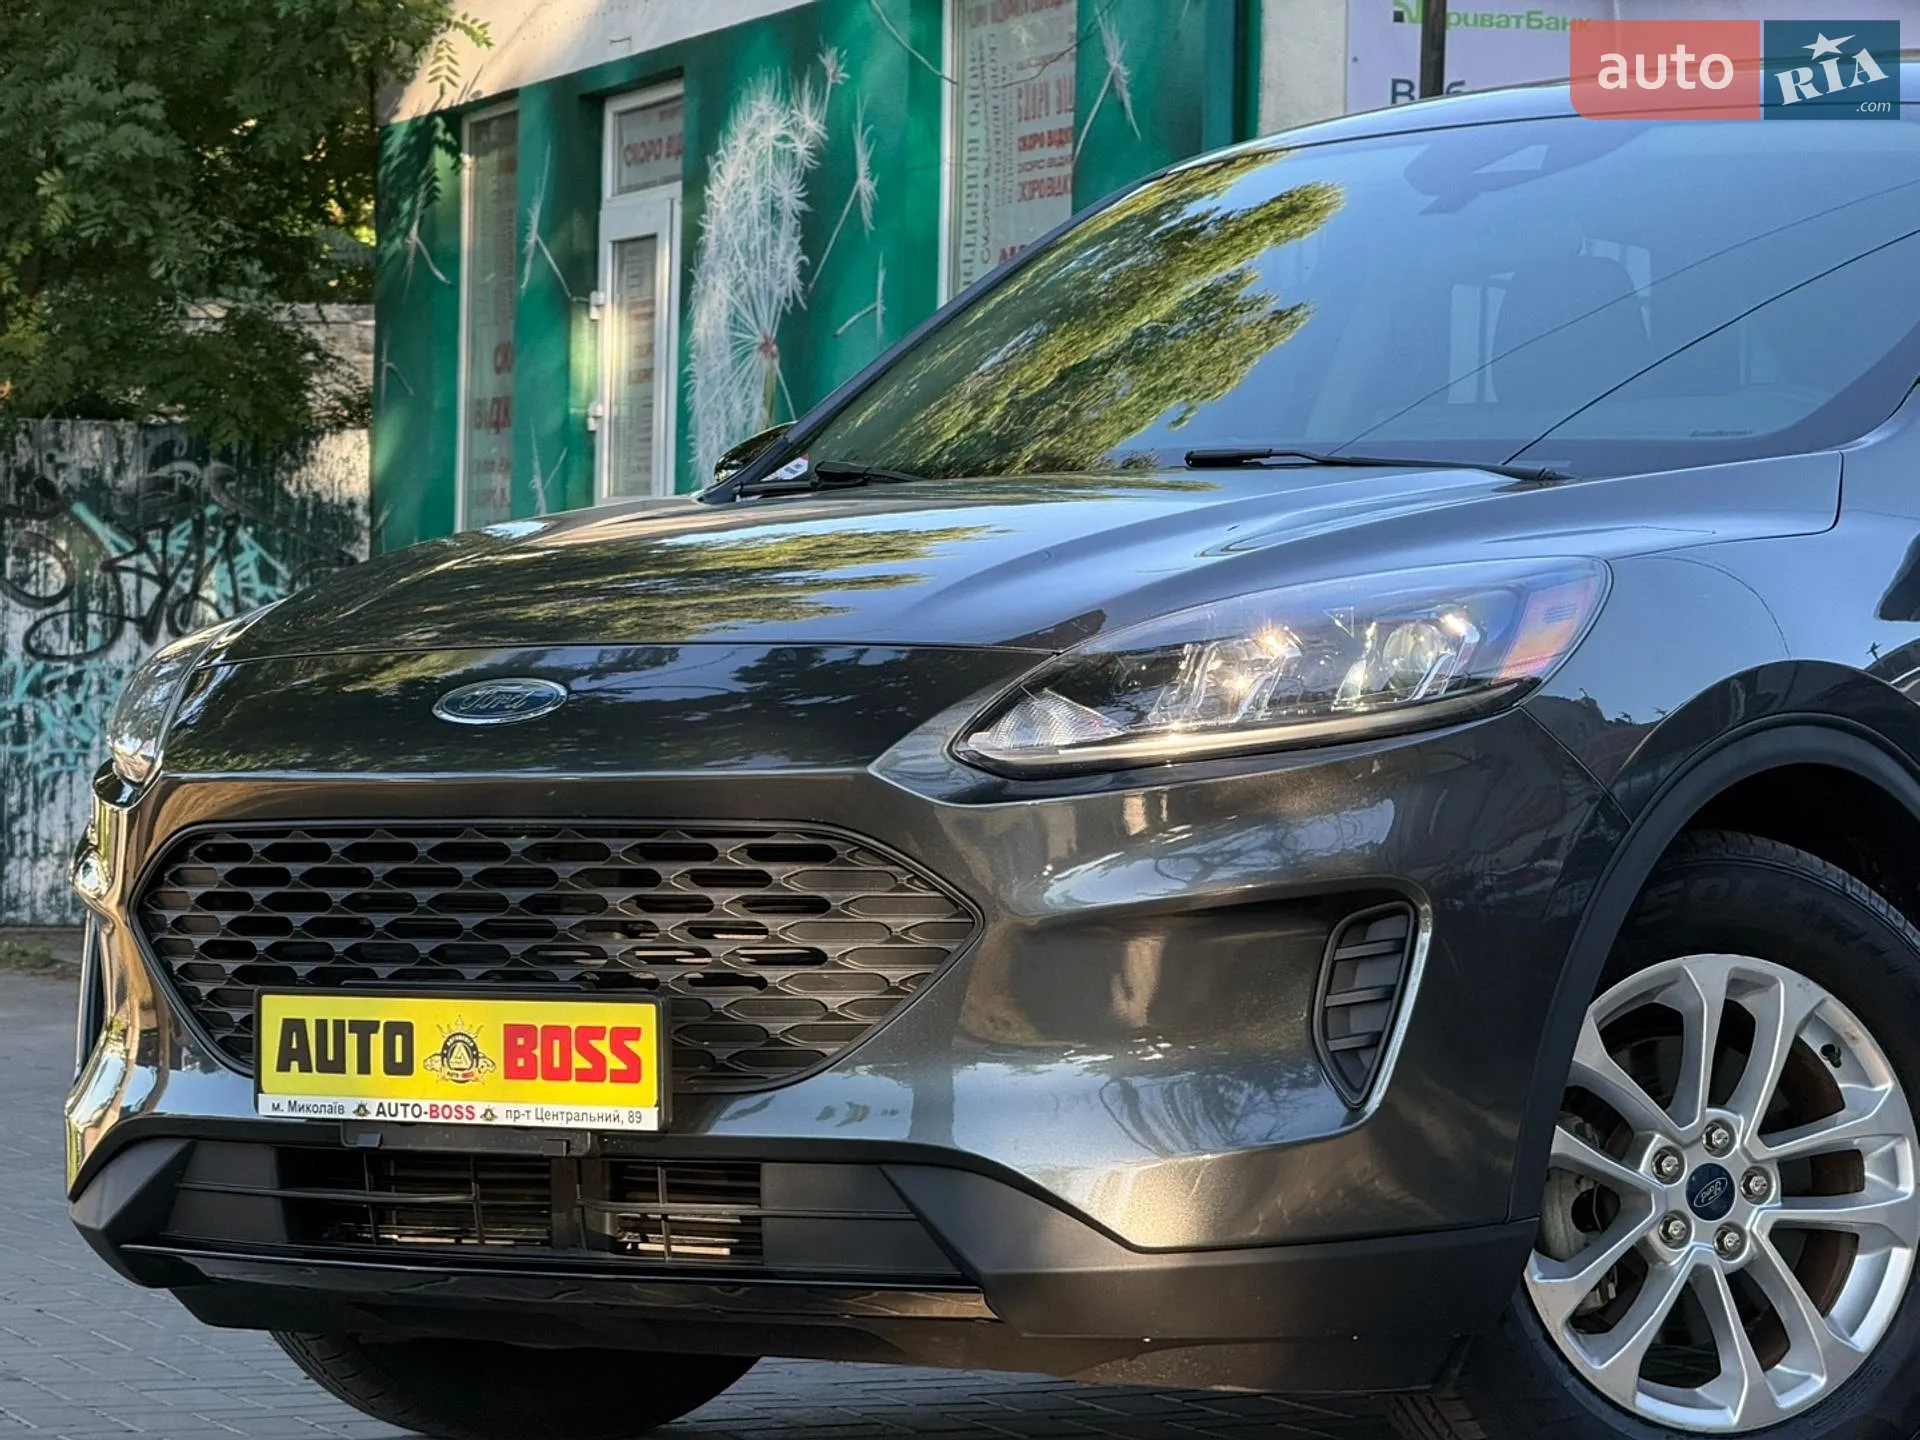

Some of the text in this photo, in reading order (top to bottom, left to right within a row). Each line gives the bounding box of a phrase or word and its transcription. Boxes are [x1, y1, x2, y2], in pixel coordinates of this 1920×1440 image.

[1446, 10, 1592, 33] риватБанк
[275, 1017, 643, 1085] AUTO BOSS
[271, 1101, 345, 1115] м. Миколаїв
[375, 1102, 476, 1121] AUTO-BOSS
[505, 1107, 643, 1126] пр-т Центральний, 89
